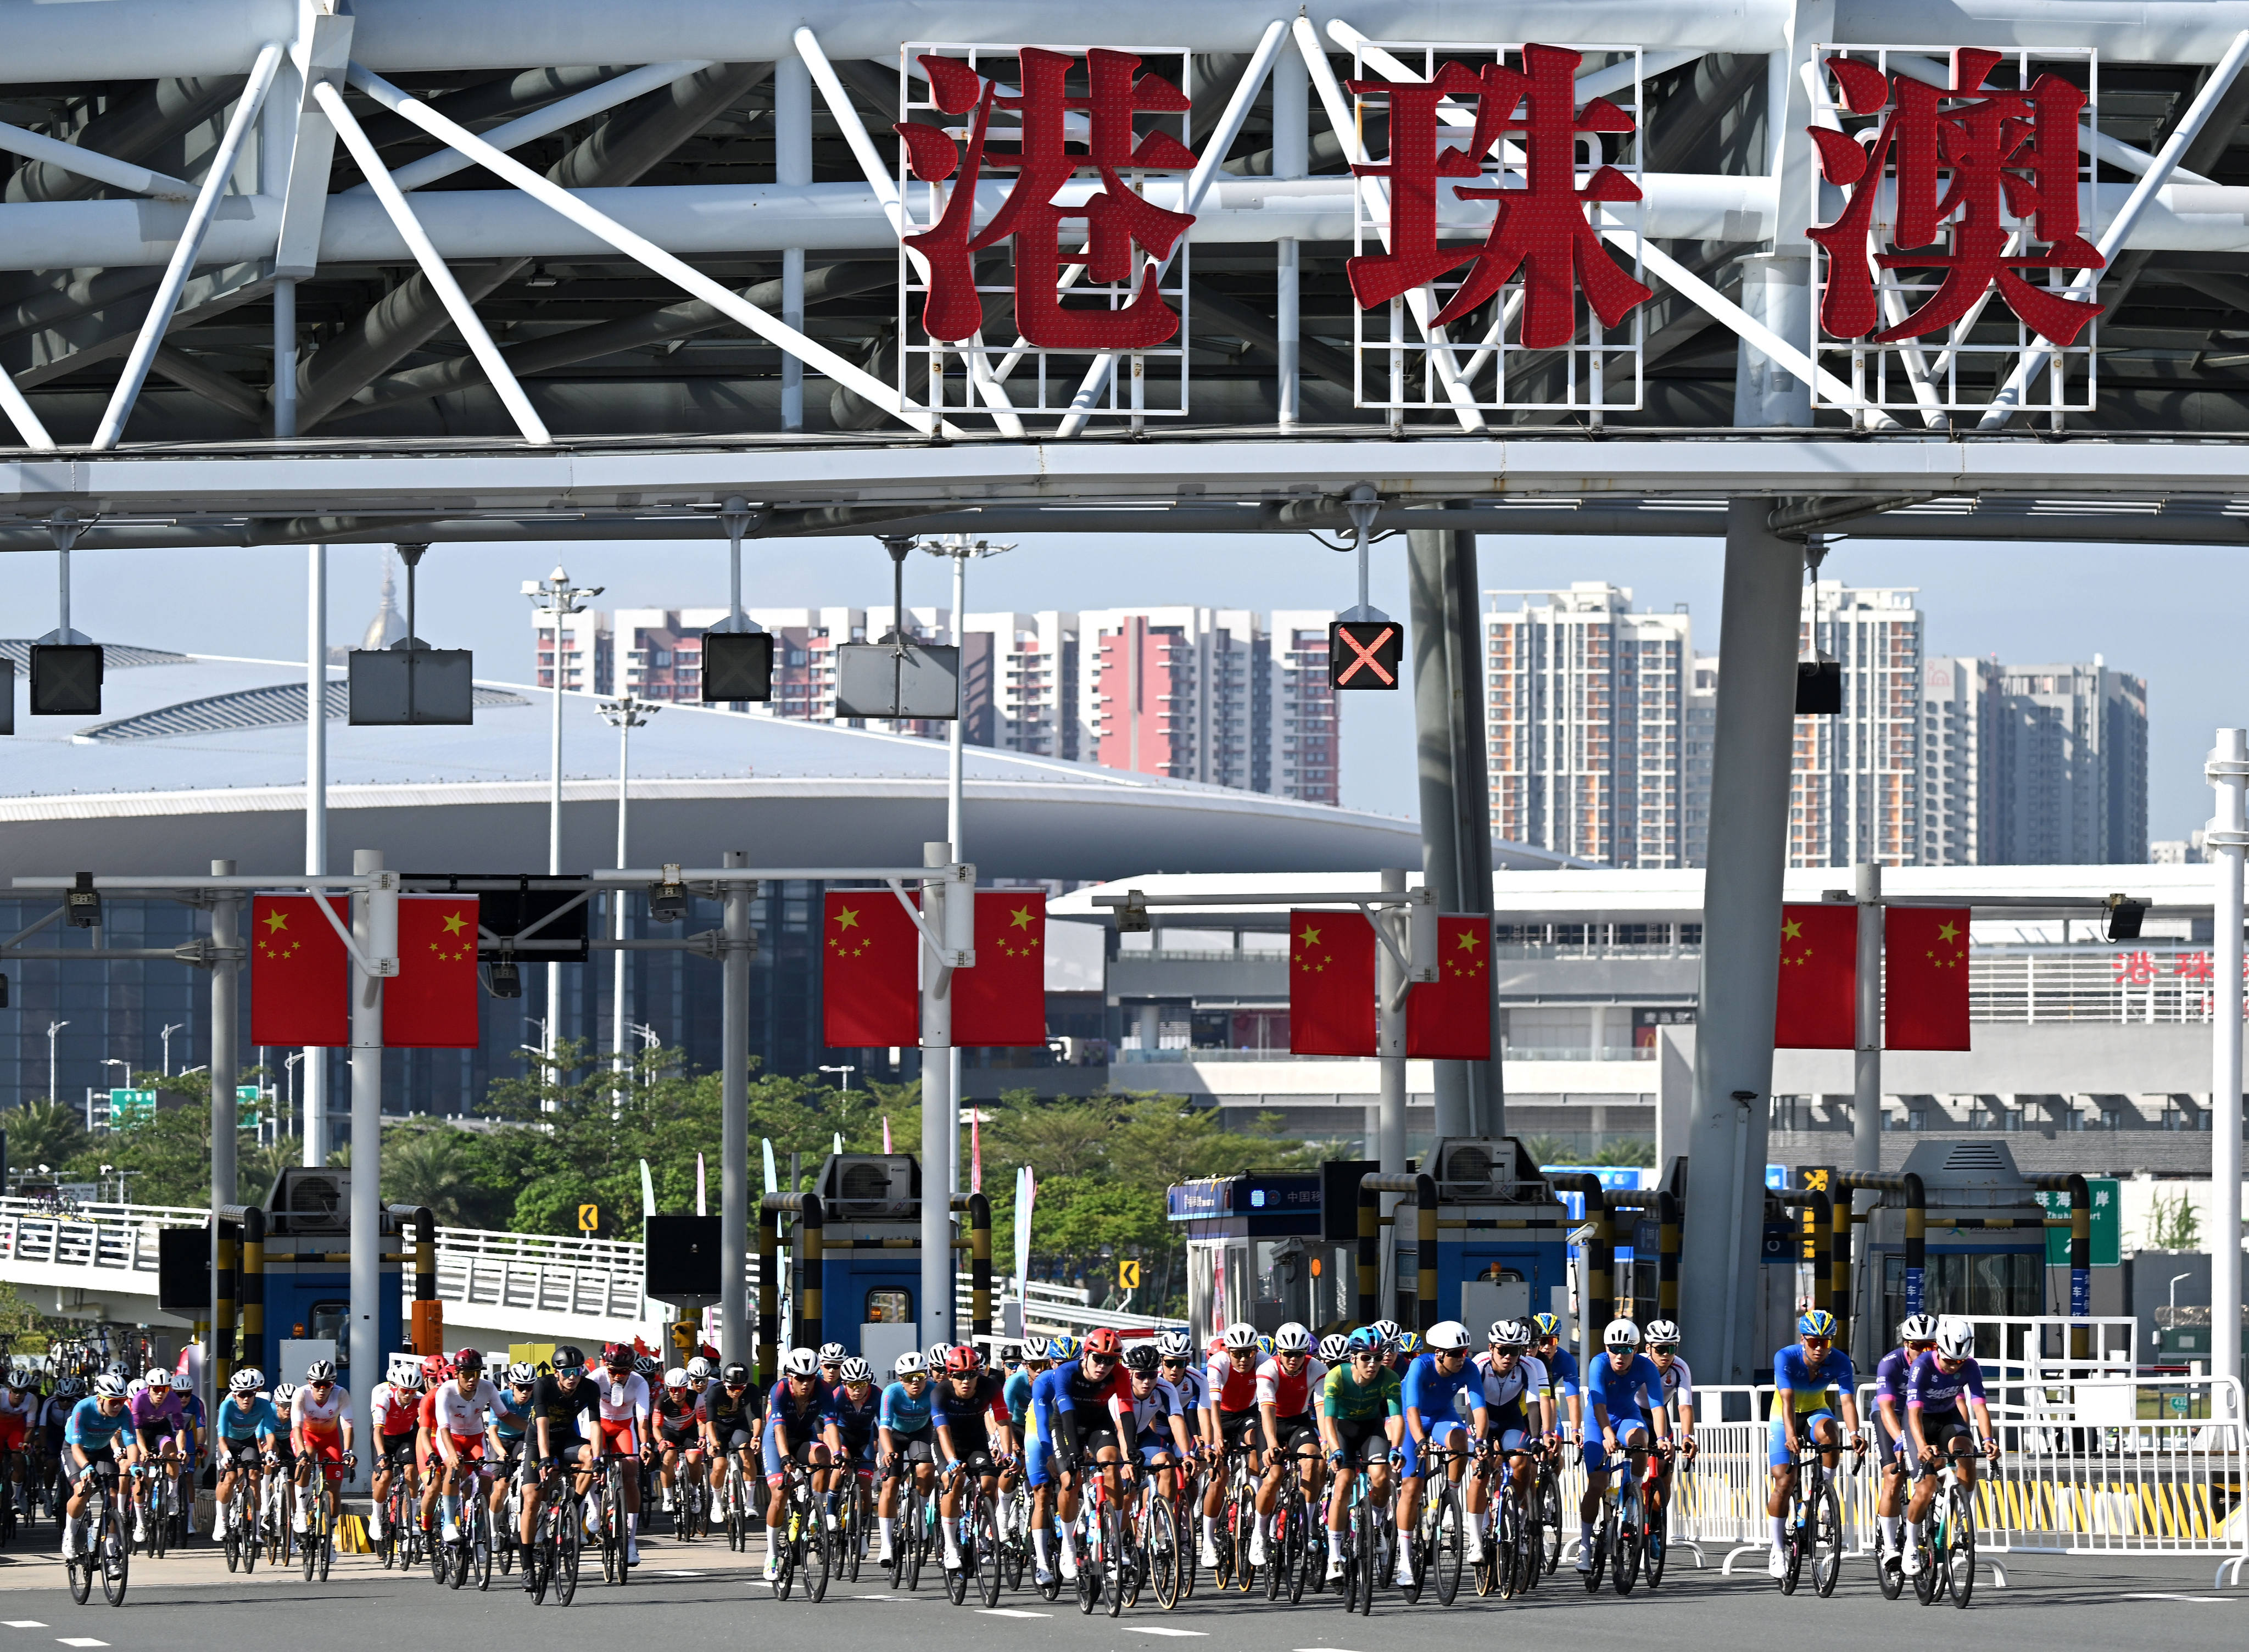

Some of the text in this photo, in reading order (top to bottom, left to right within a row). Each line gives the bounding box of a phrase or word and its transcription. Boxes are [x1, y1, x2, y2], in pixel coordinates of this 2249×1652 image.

[892, 43, 2106, 350] 港珠澳
[2112, 951, 2249, 985] 港珠
[2035, 1190, 2110, 1208] 珠海岸
[2046, 1211, 2072, 1219] Zhuh
